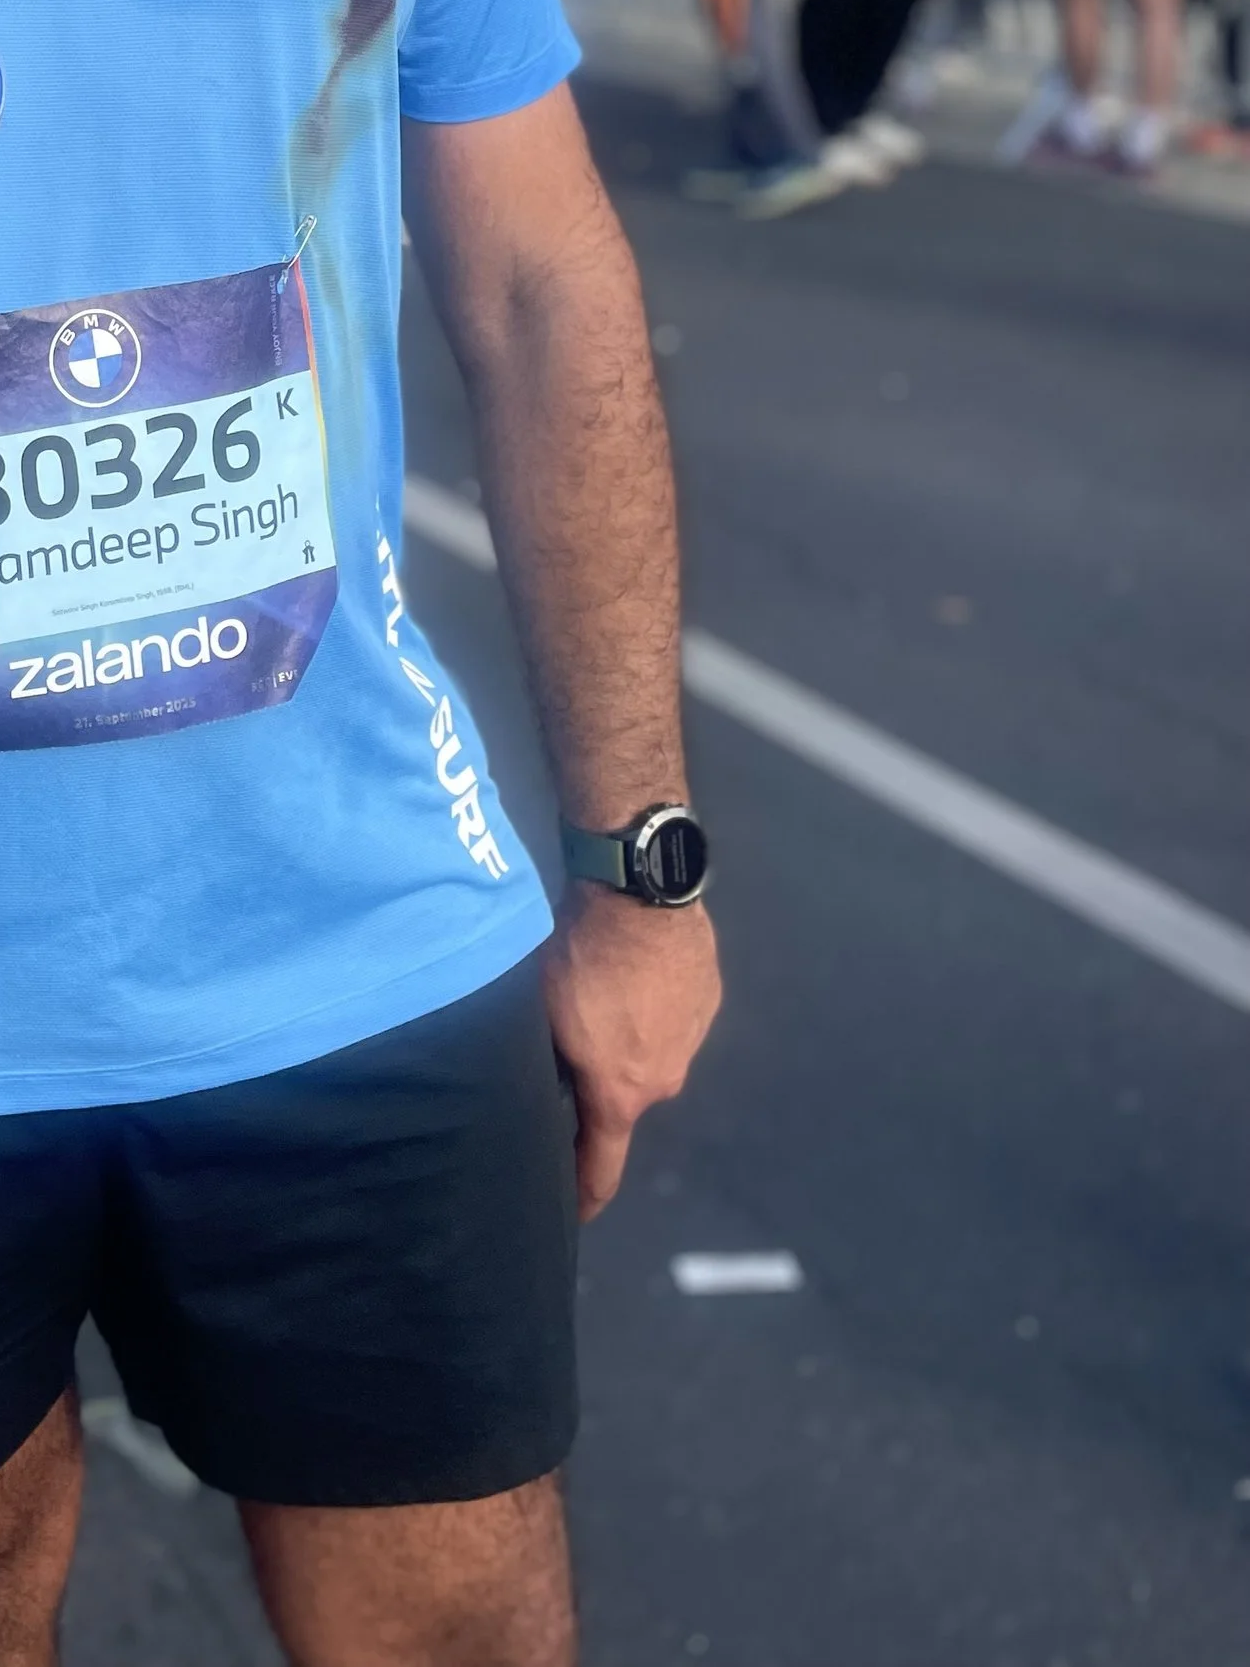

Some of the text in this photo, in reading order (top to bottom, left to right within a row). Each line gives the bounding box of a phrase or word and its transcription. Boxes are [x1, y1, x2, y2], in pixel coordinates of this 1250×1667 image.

[59, 314, 125, 346] BMW
[276, 387, 300, 420] K
[190, 483, 299, 547] Singh
[8, 616, 249, 700] zalando
[166, 697, 197, 714] 2025
